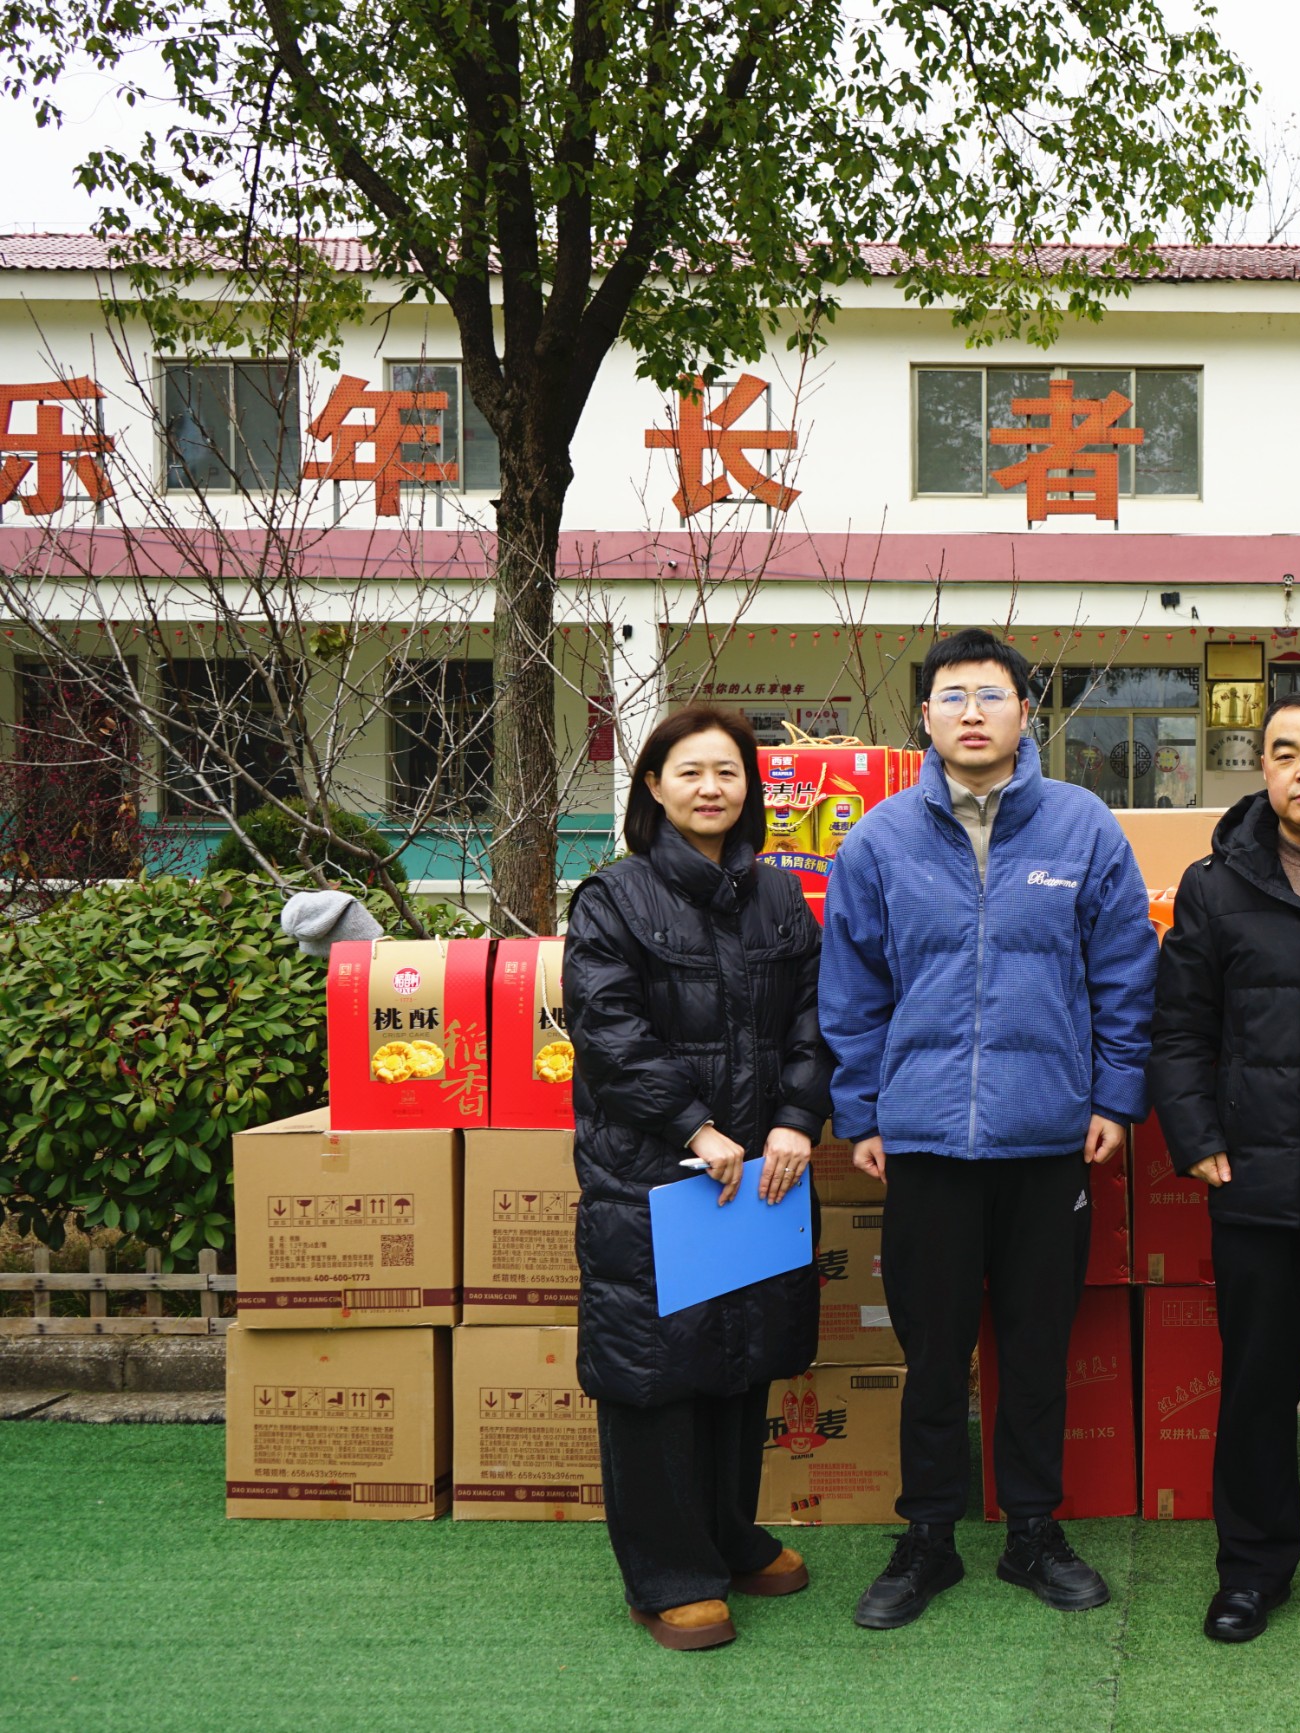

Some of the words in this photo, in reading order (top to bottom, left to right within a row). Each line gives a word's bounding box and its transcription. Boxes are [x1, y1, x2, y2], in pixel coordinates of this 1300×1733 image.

[771, 756, 793, 766] 西麦
[781, 855, 828, 873] 肠胃舒服
[373, 1007, 440, 1031] 桃酥
[314, 1274, 370, 1282] 400-600-1773
